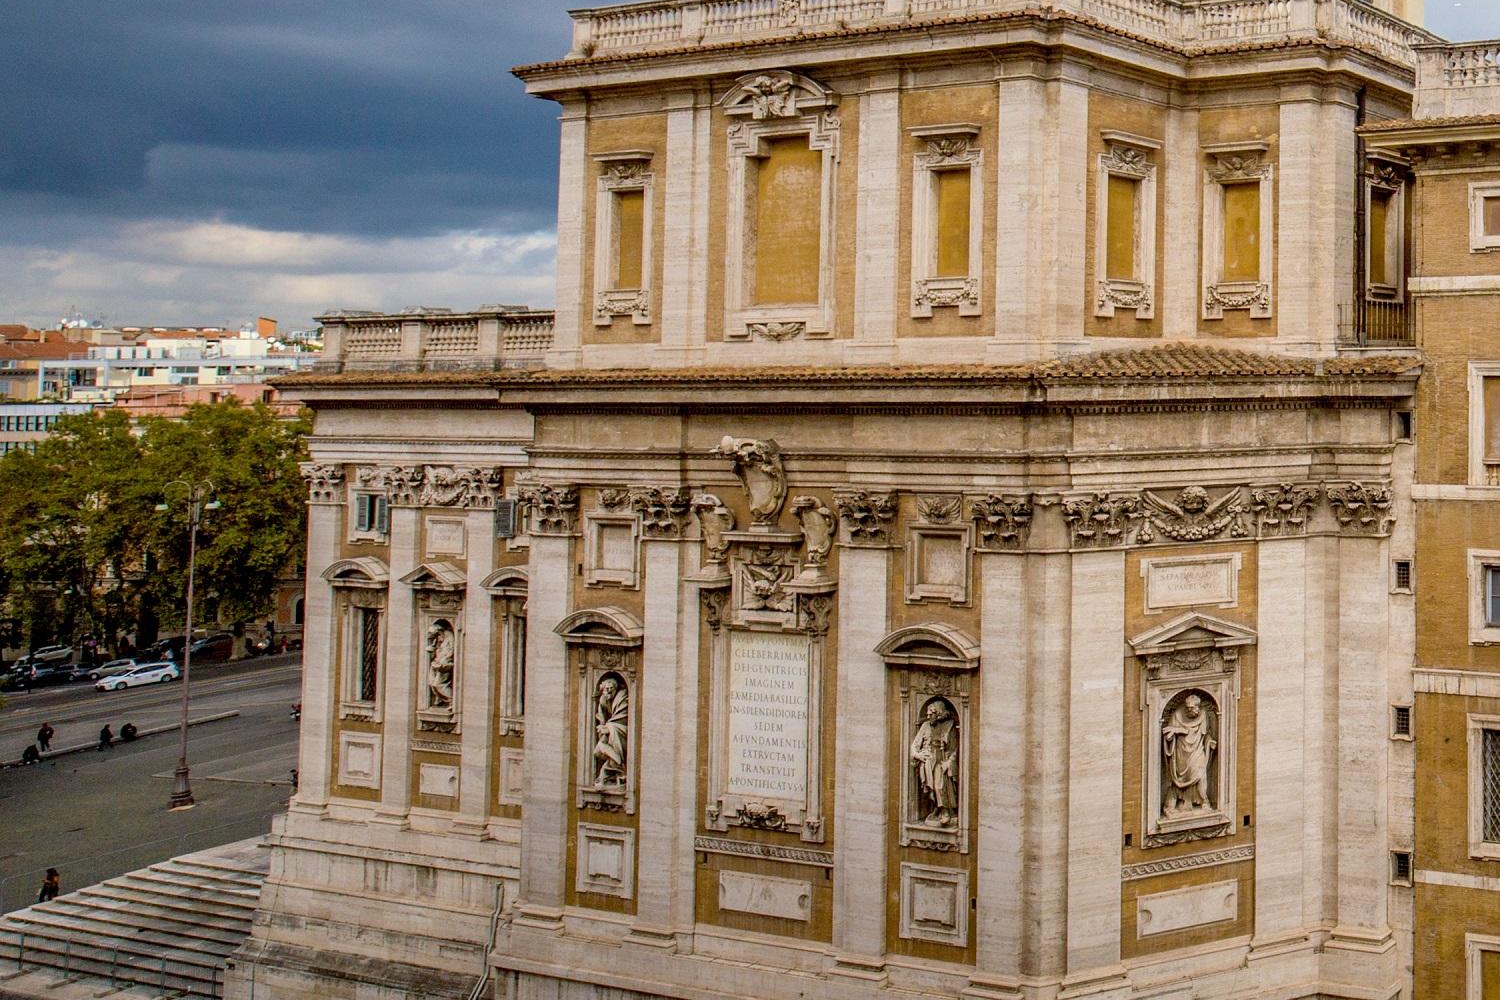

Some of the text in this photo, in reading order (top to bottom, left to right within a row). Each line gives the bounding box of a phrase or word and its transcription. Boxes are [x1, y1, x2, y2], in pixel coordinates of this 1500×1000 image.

[735, 648, 806, 662] CELEBERRIMAM
[745, 677, 794, 690] IMAGINEM
[754, 721, 783, 732] SEDEM
[742, 748, 794, 762] EXTRVCTAM
[741, 763, 796, 777] TRANSTVLIT
